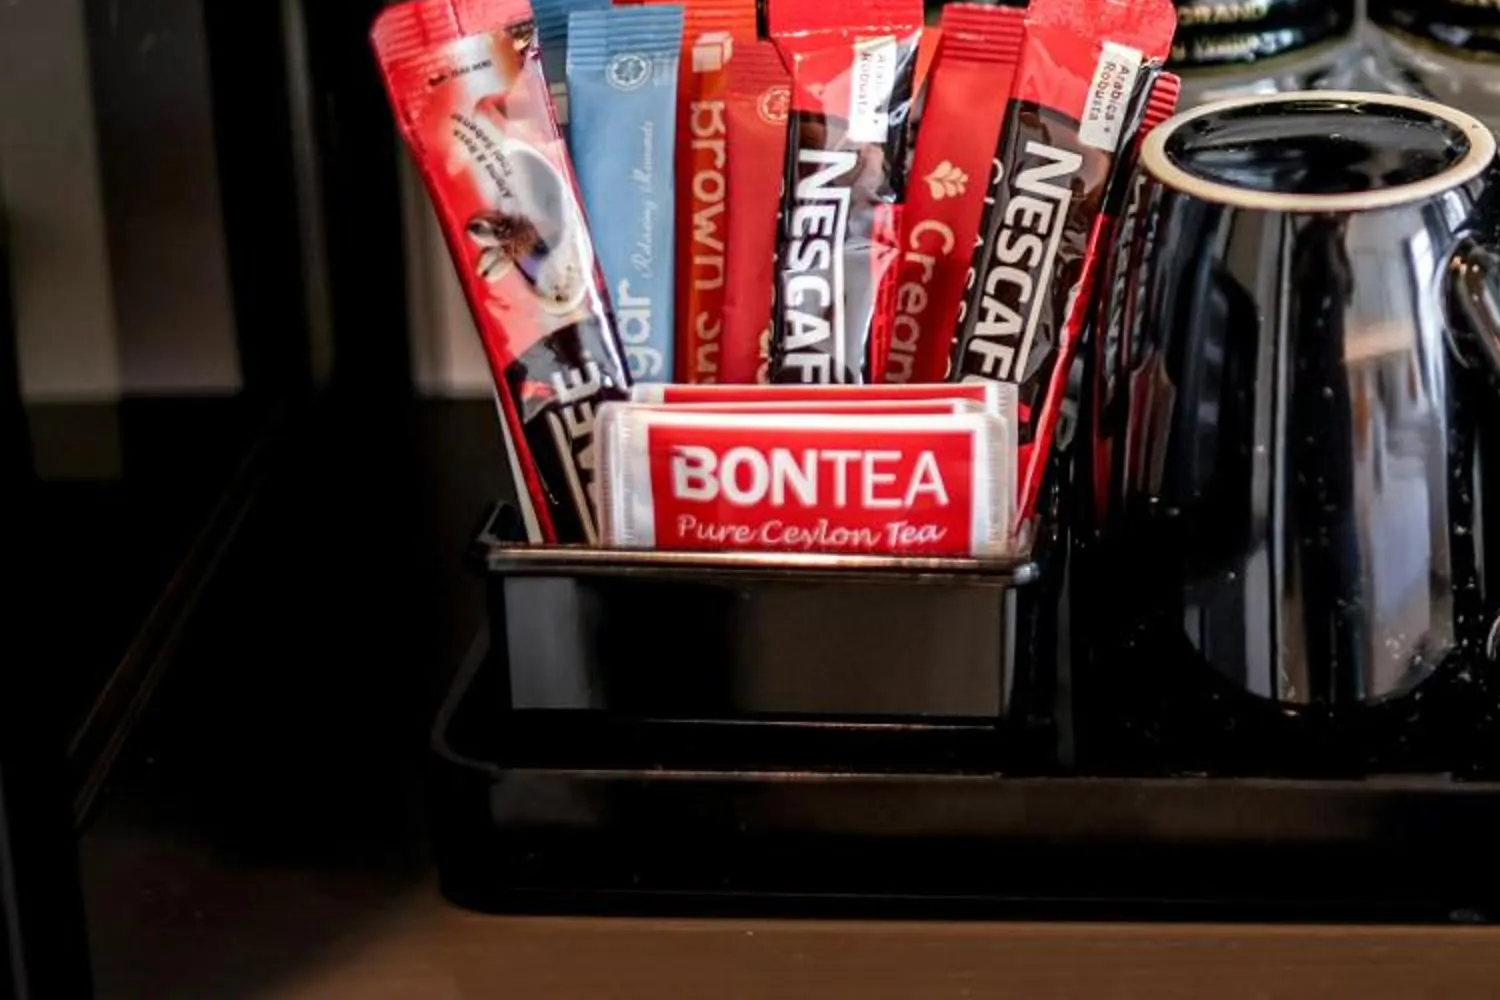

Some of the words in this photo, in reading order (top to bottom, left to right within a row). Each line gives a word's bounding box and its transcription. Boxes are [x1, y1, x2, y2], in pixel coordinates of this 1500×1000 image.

[1087, 59, 1118, 123] Robusta
[1103, 63, 1130, 123] Arabica
[690, 101, 727, 291] Brown
[782, 148, 860, 384] NESCAF
[968, 140, 1083, 386] NESCAF
[618, 278, 663, 379] gar
[671, 445, 949, 508] BONTEA
[677, 513, 758, 543] Pure
[760, 515, 882, 549] Ceylon
[887, 519, 946, 544] Tea
